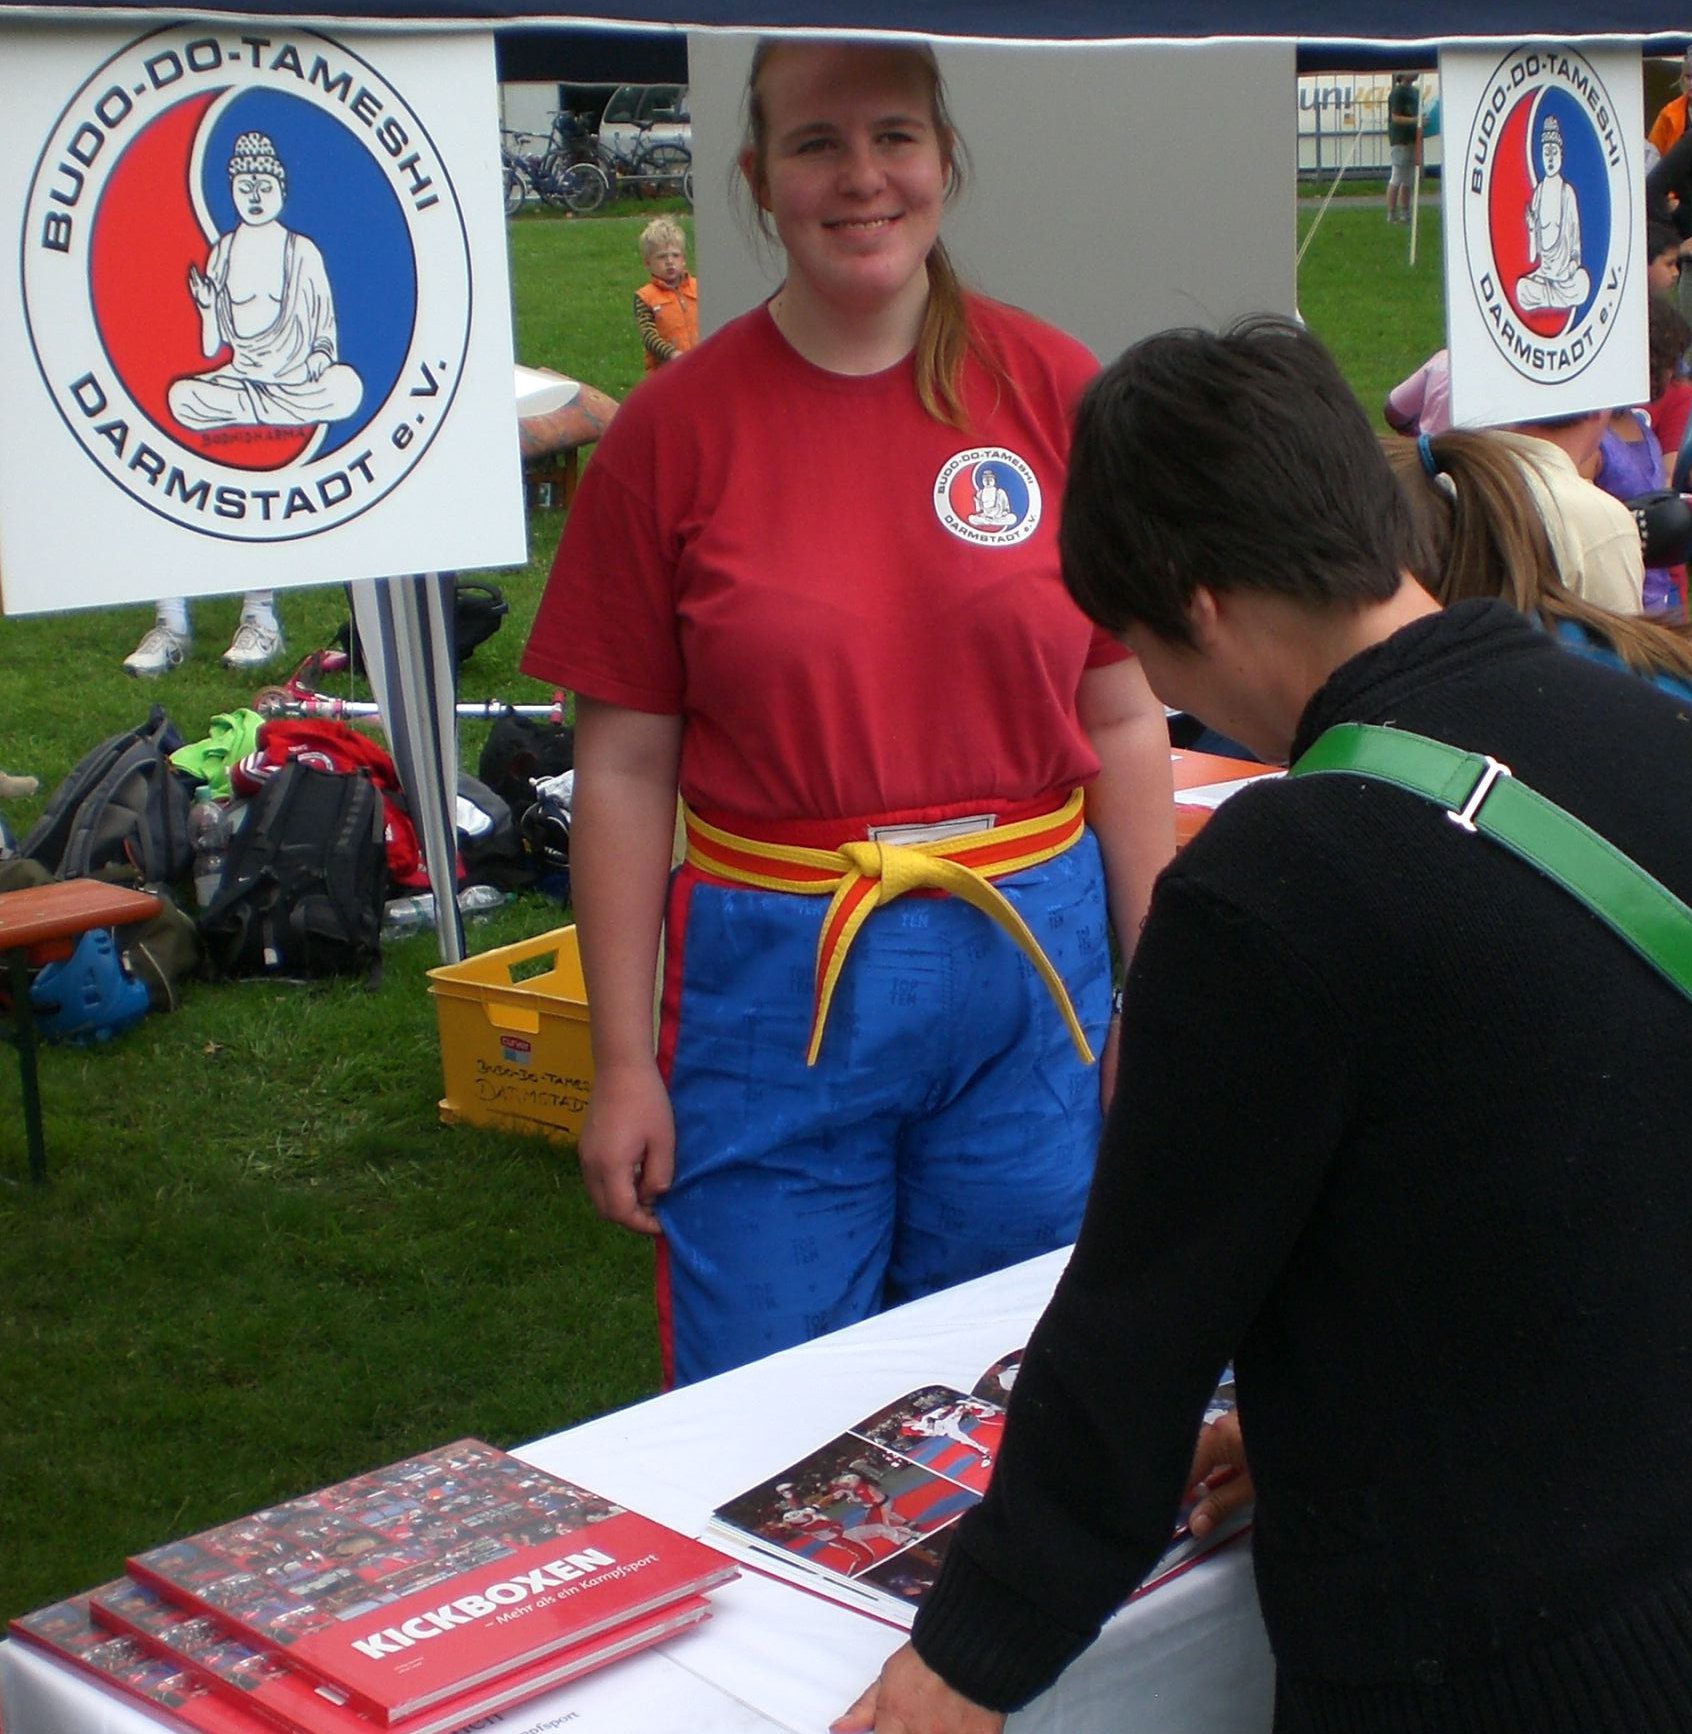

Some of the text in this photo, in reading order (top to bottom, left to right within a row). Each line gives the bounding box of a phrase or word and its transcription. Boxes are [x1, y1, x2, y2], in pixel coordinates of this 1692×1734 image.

[42, 37, 439, 253] BUDO-DO-TAMESHI
[1471, 53, 1620, 195] BUDO-DO-TAMESHI
[1480, 272, 1595, 370] DARMSTADT
[69, 360, 447, 521] DARMSTADT e.V.
[938, 450, 1034, 494] BUDO-DO-TAMESHI
[944, 514, 1021, 543] DARMSTADT
[351, 1547, 616, 1660] KICKBOXEN
[496, 1603, 534, 1625] Mehr
[536, 1593, 557, 1609] als
[557, 1584, 580, 1600] ein
[579, 1552, 661, 1590] Kampfsport
